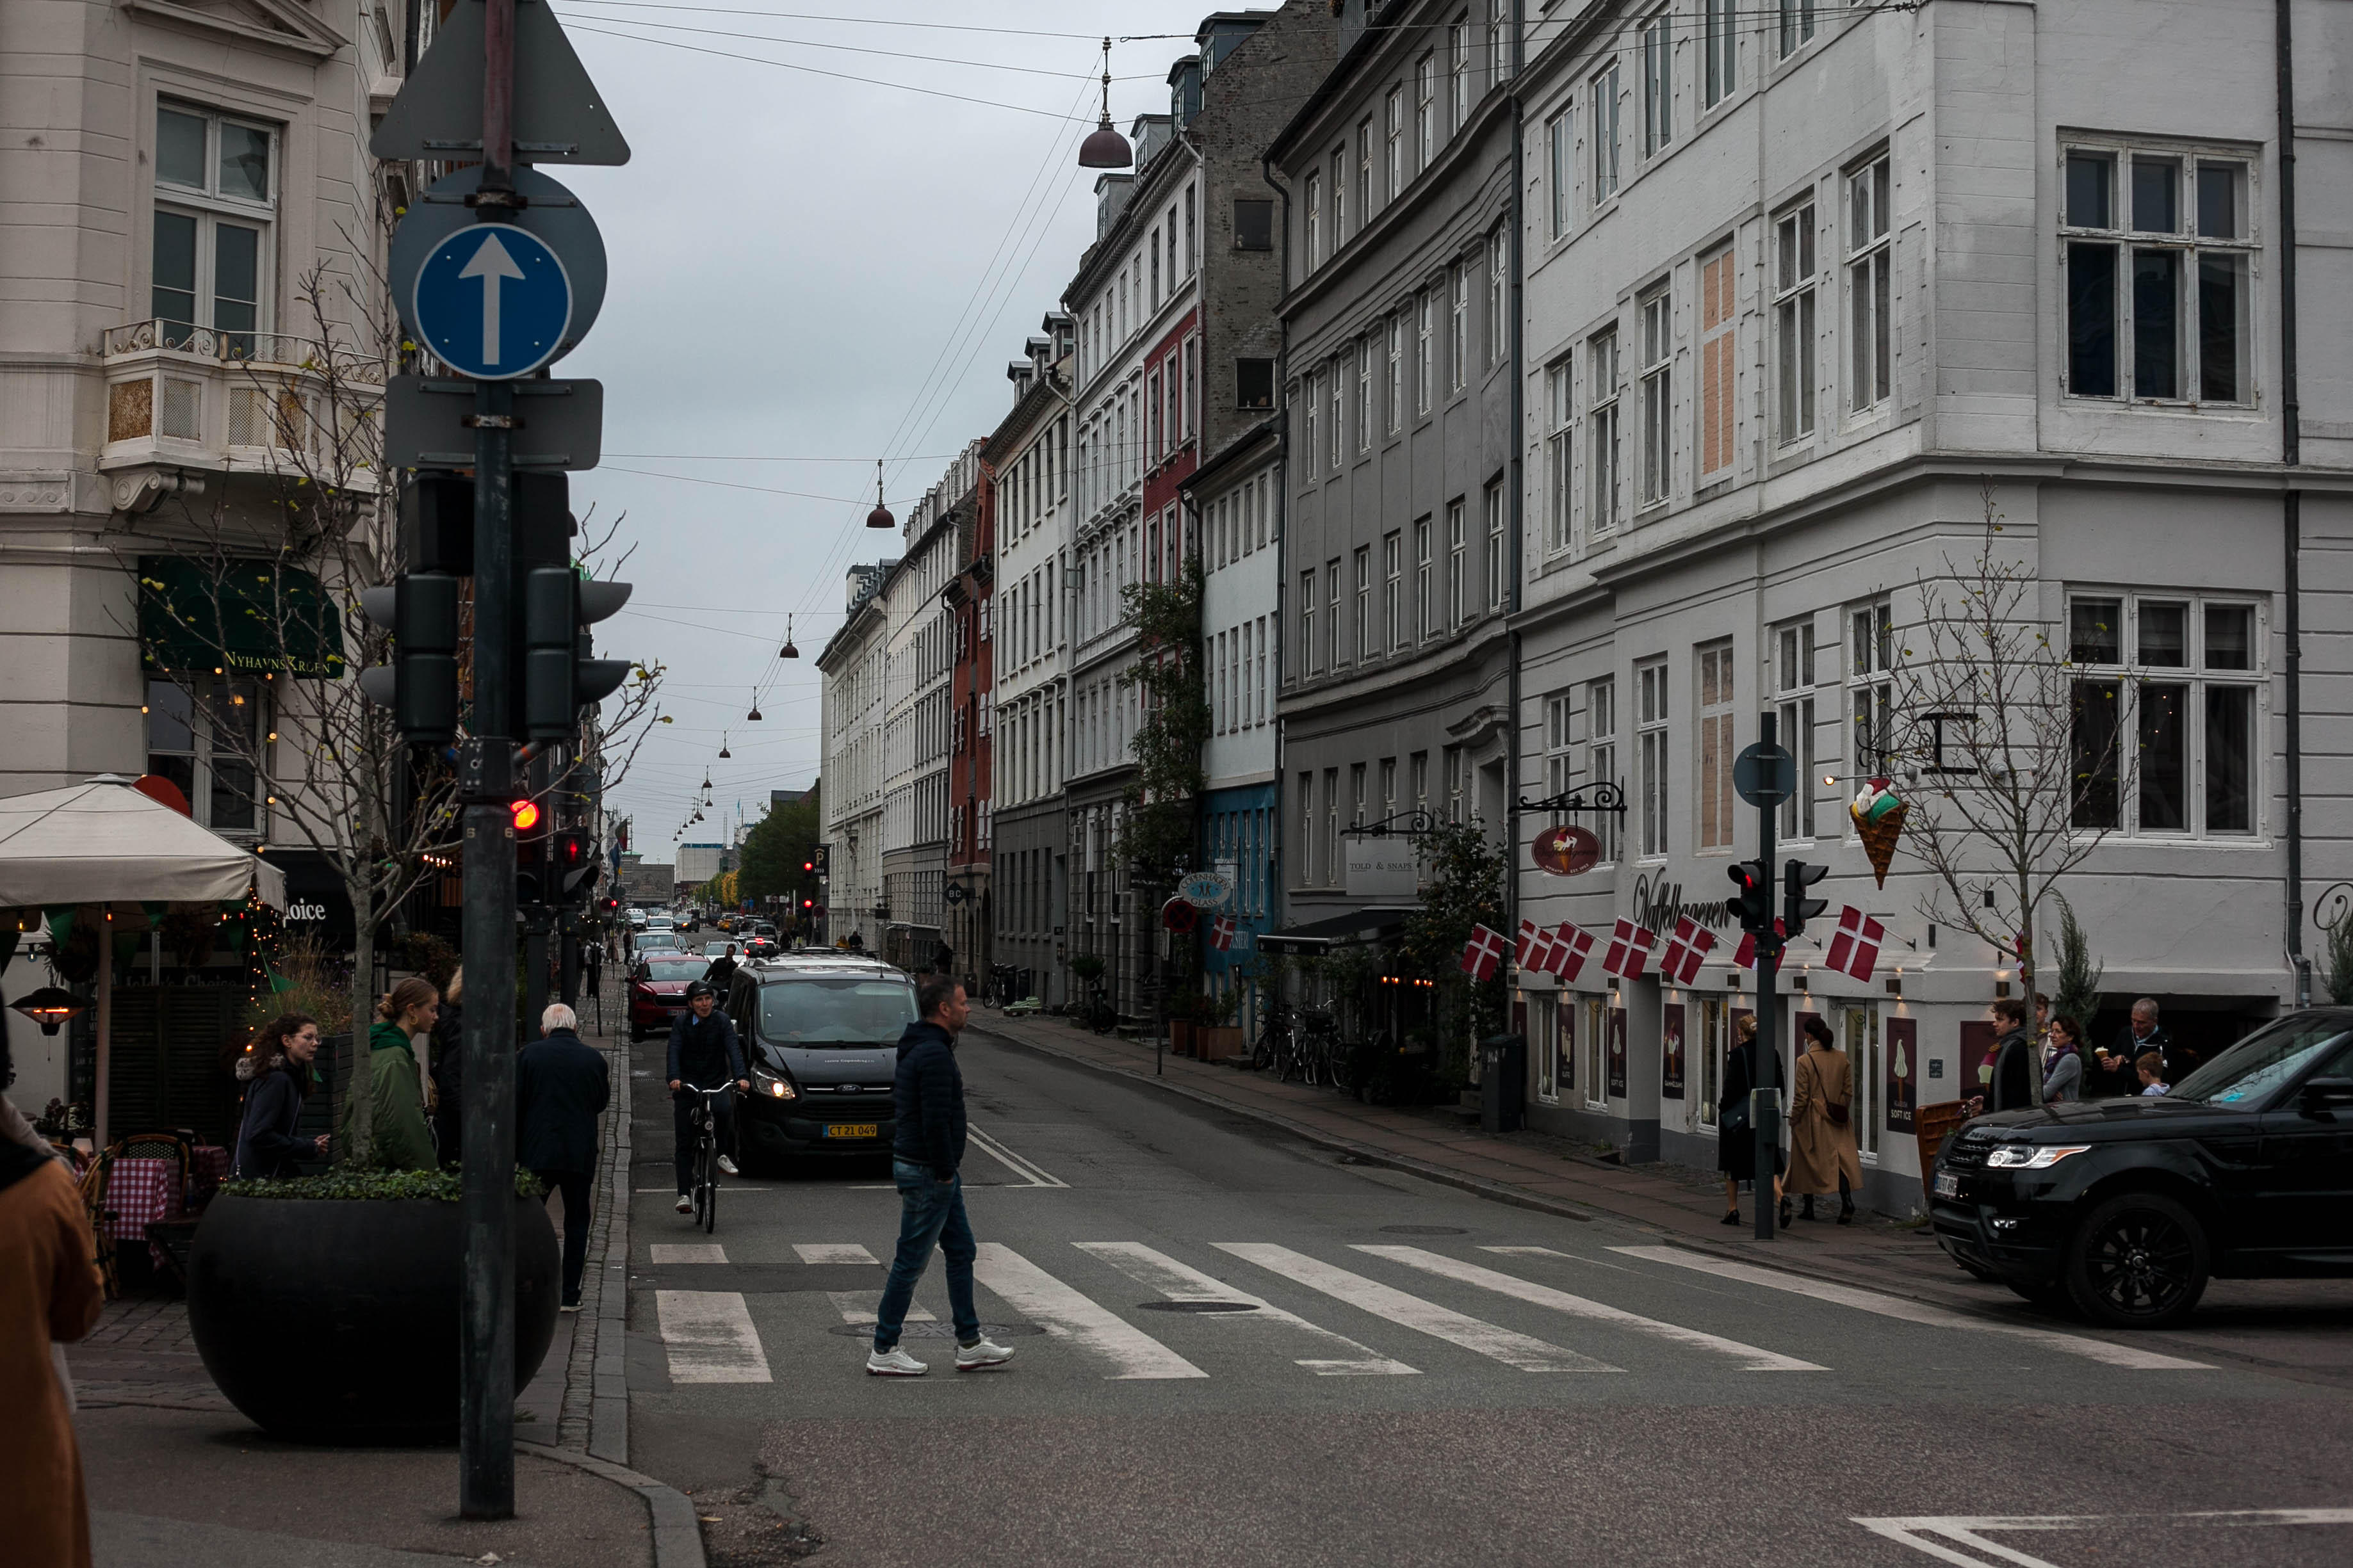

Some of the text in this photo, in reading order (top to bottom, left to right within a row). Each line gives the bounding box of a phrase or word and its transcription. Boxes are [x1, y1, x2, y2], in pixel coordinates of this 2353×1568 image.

[816, 852, 824, 866] P
[1376, 862, 1384, 870] &
[1182, 873, 1229, 889] COPENHAGEN
[1191, 898, 1217, 907] GLASS
[286, 897, 327, 920] oice
[1891, 1109, 1903, 1119] SOFT
[829, 1126, 875, 1136] CT 21 049
